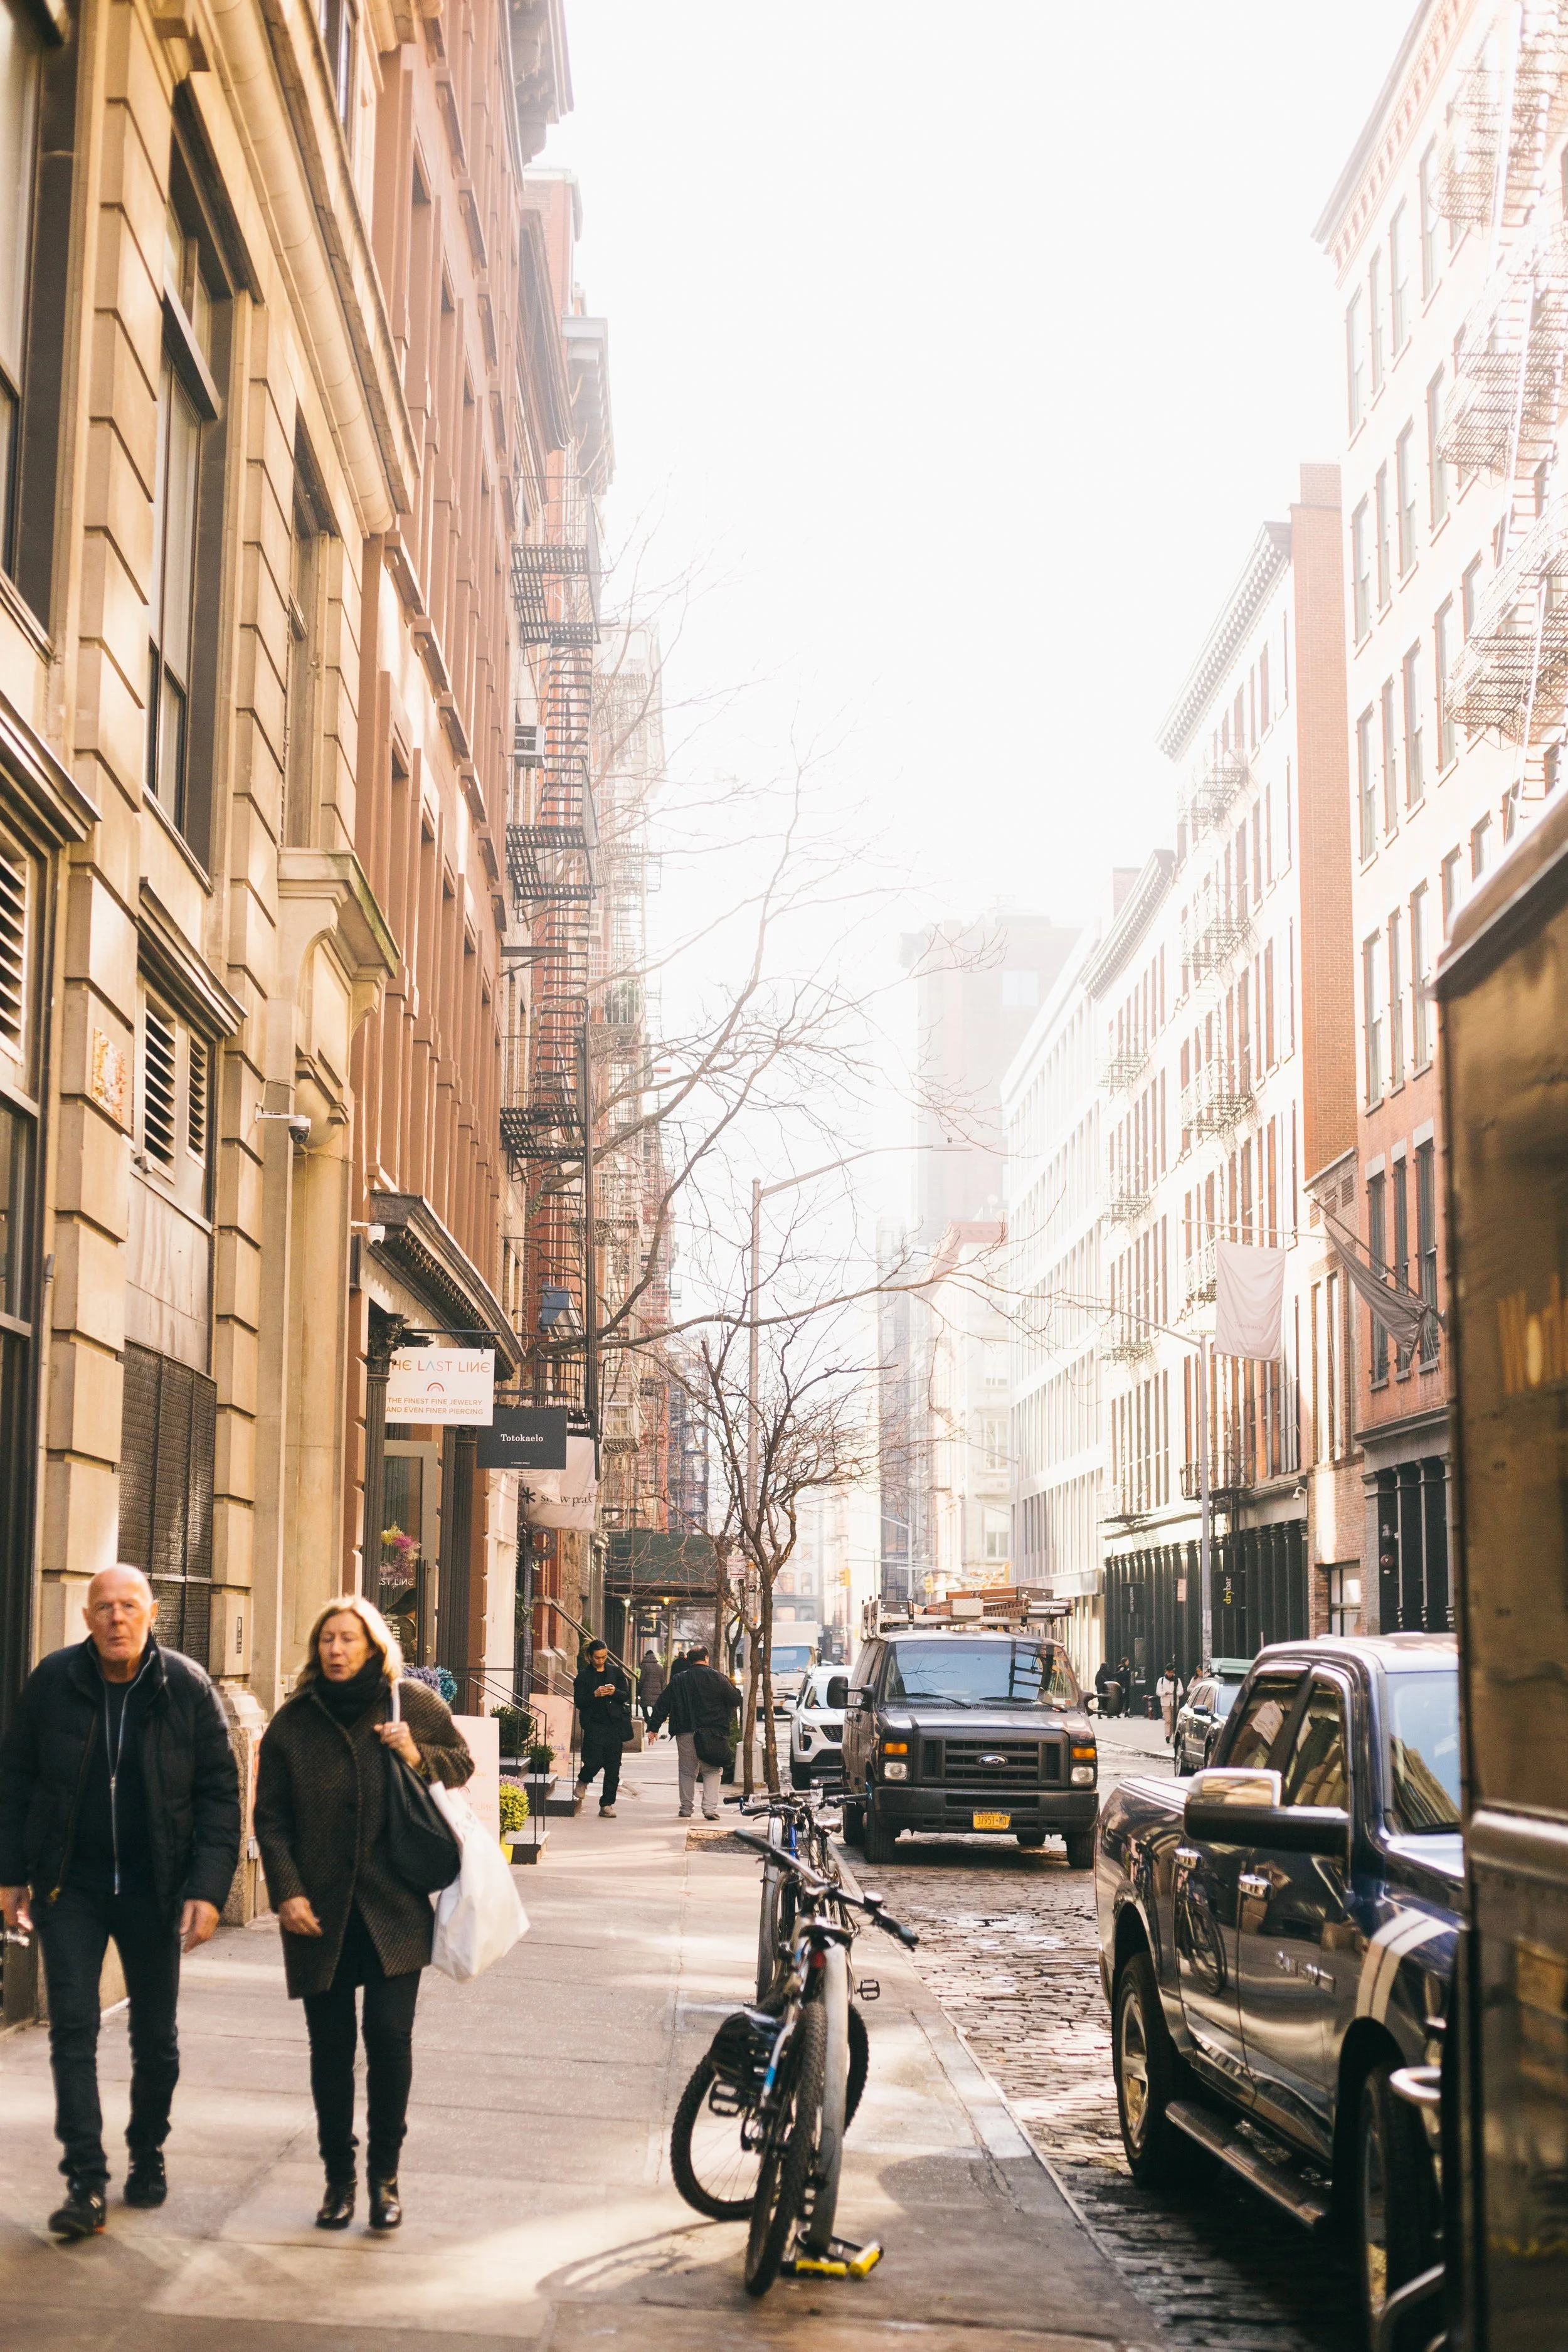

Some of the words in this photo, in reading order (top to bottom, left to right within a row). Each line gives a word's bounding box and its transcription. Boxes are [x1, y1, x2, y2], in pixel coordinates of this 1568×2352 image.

[418, 1360, 453, 1372] LAST
[458, 1361, 490, 1373] LINE
[501, 1433, 544, 1442] Totokaelo
[540, 1495, 571, 1503] snw
[1223, 1576, 1234, 1605] drybar
